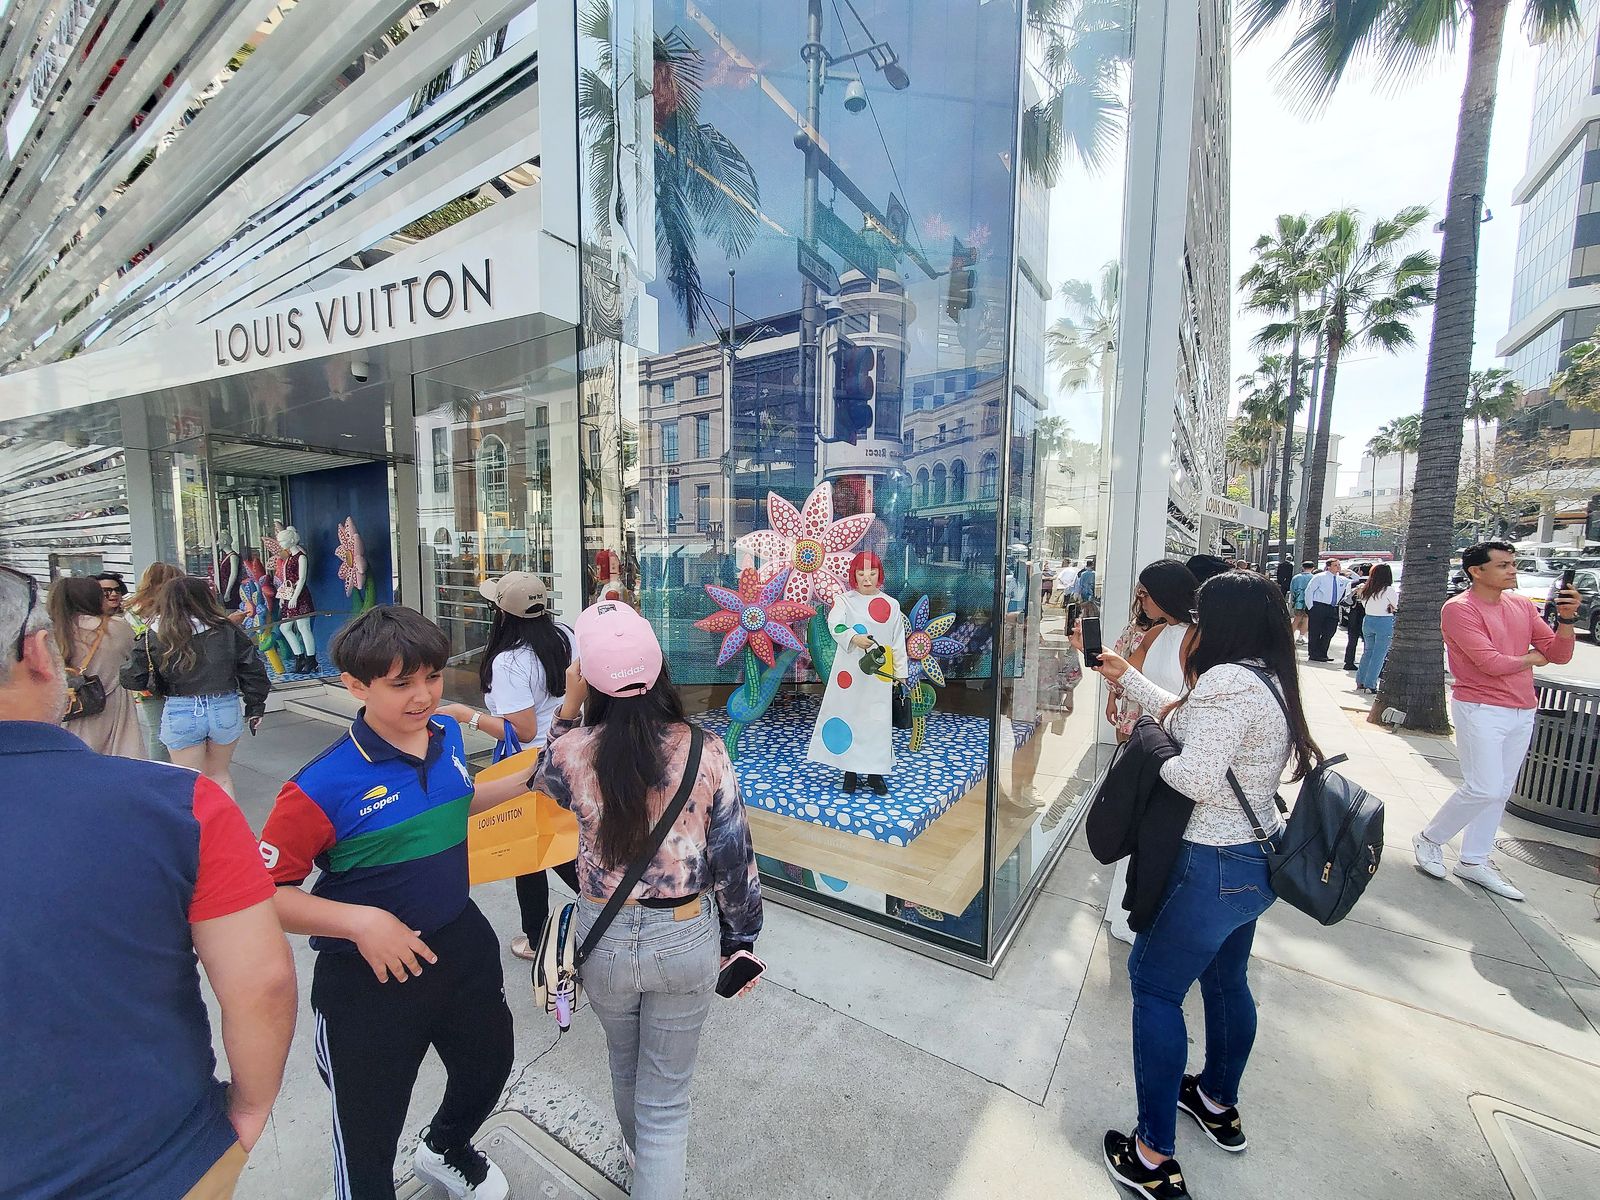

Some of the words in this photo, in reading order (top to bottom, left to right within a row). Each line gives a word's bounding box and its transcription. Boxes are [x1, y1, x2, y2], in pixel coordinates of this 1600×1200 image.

[215, 307, 303, 367] LOUIS
[315, 258, 494, 344] VUITTON
[610, 664, 645, 680] adidas
[359, 805, 373, 816] us
[373, 792, 399, 809] open
[478, 815, 496, 830] LOUIS
[496, 807, 523, 823] VUITTON
[258, 840, 280, 869] 9
